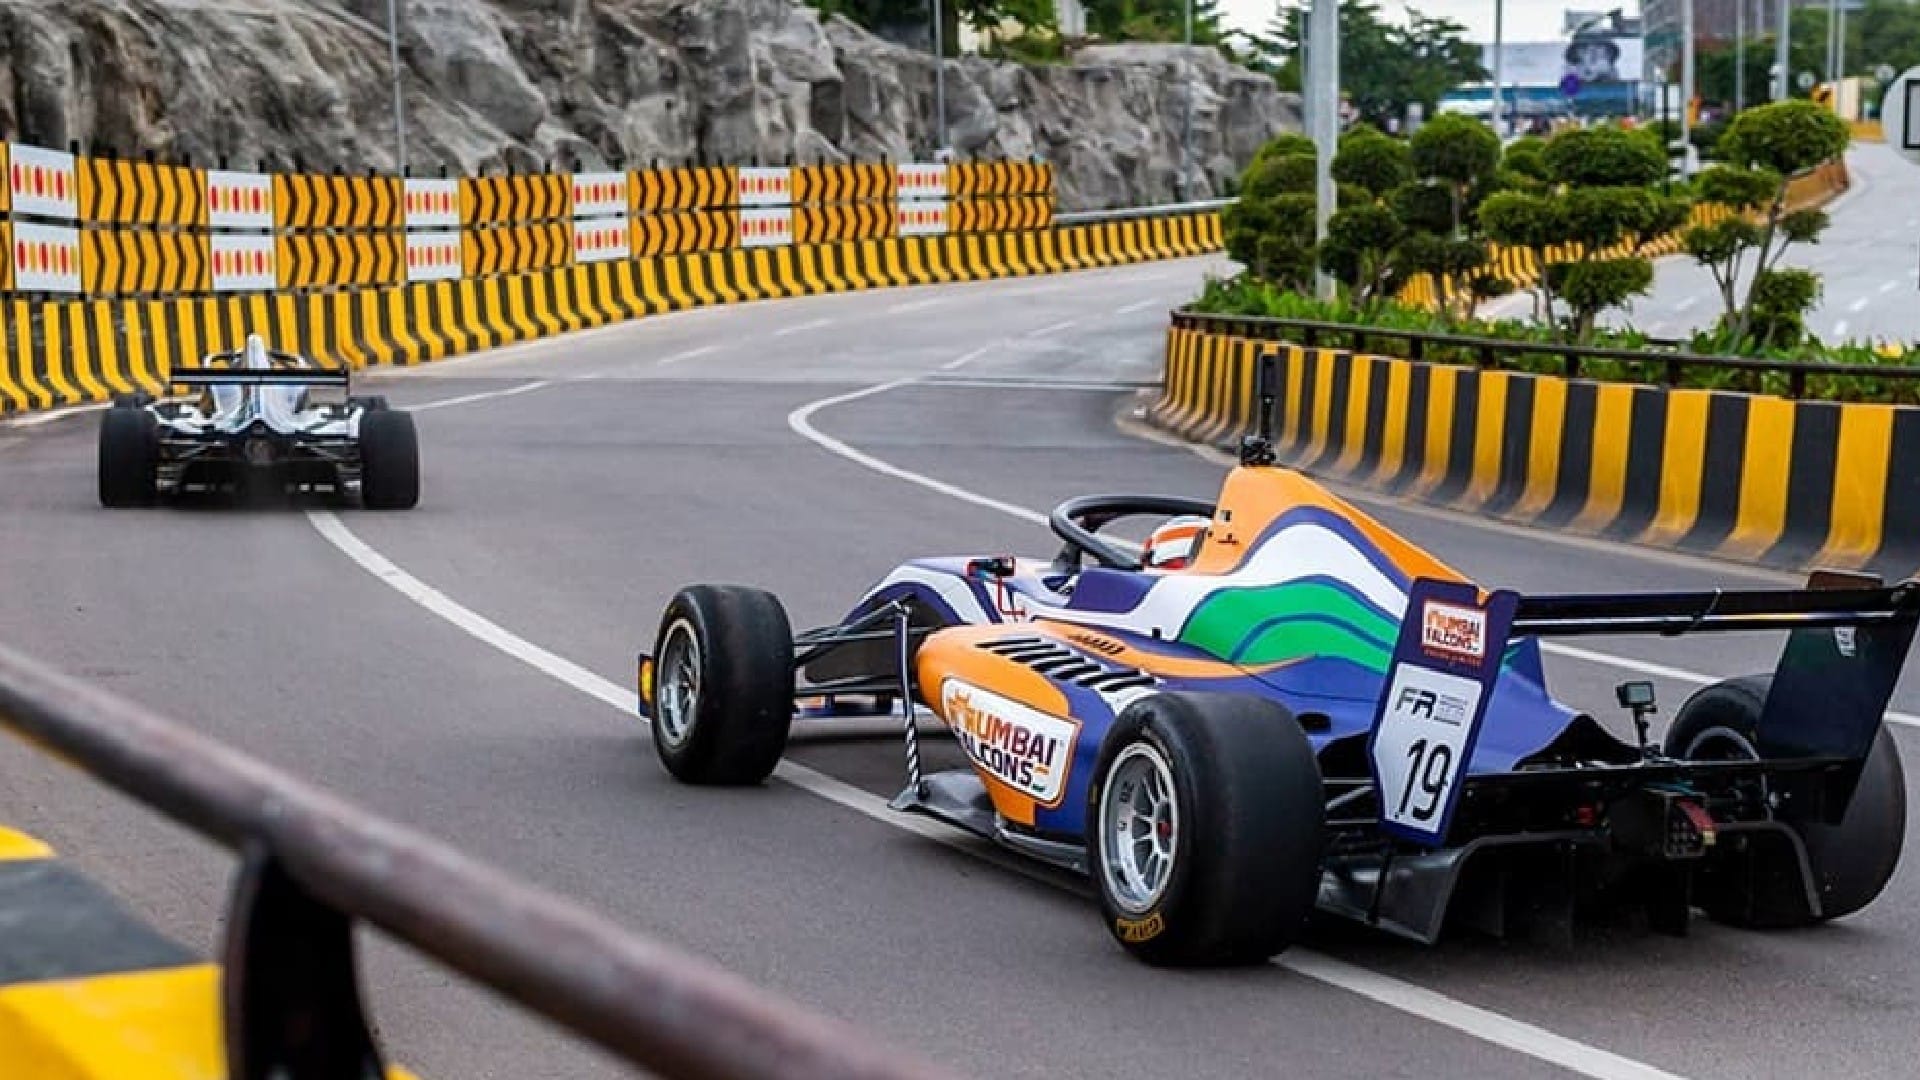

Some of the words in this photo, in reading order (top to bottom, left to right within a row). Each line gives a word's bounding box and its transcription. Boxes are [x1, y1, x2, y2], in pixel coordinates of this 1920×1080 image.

[946, 689, 1057, 768] MUMBAI
[1395, 687, 1437, 719] FR
[1398, 738, 1451, 821] 19
